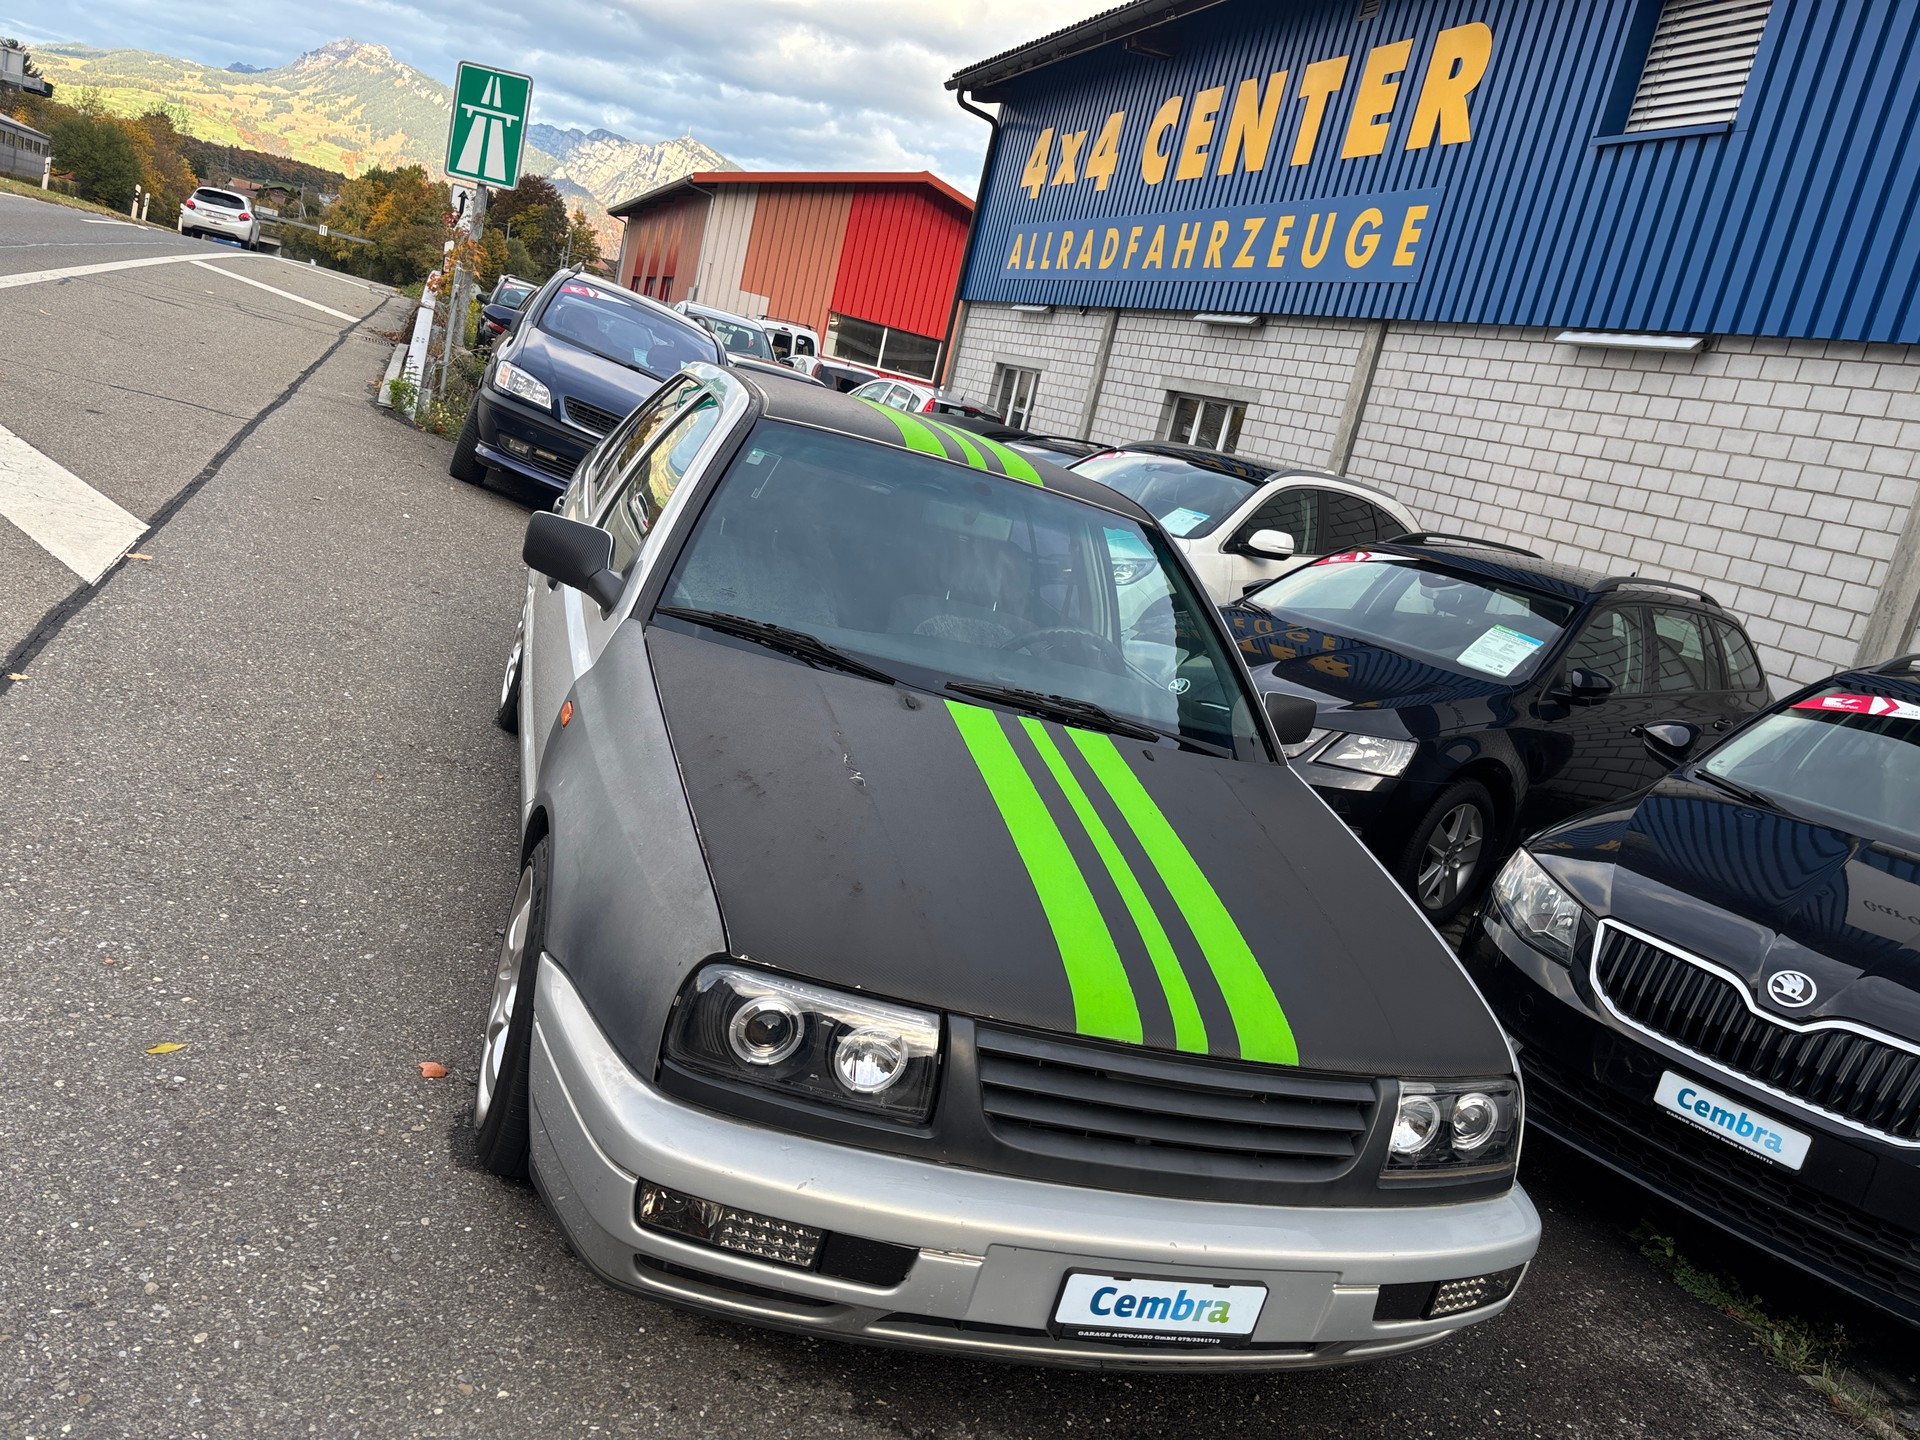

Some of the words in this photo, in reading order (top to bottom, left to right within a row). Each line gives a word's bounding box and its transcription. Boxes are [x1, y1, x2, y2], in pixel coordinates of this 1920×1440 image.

[1021, 111, 1124, 199] 4x4
[1142, 22, 1493, 185] CENTER
[1007, 205, 1429, 270] ALLRADFAHRZEUGE
[1666, 1110, 1690, 1125] GARAGE
[1677, 1087, 1783, 1154] Cembra
[1089, 1286, 1232, 1324] Cembra
[1077, 1330, 1111, 1338] GARAGE
[1112, 1332, 1154, 1340] AUTOJARO
